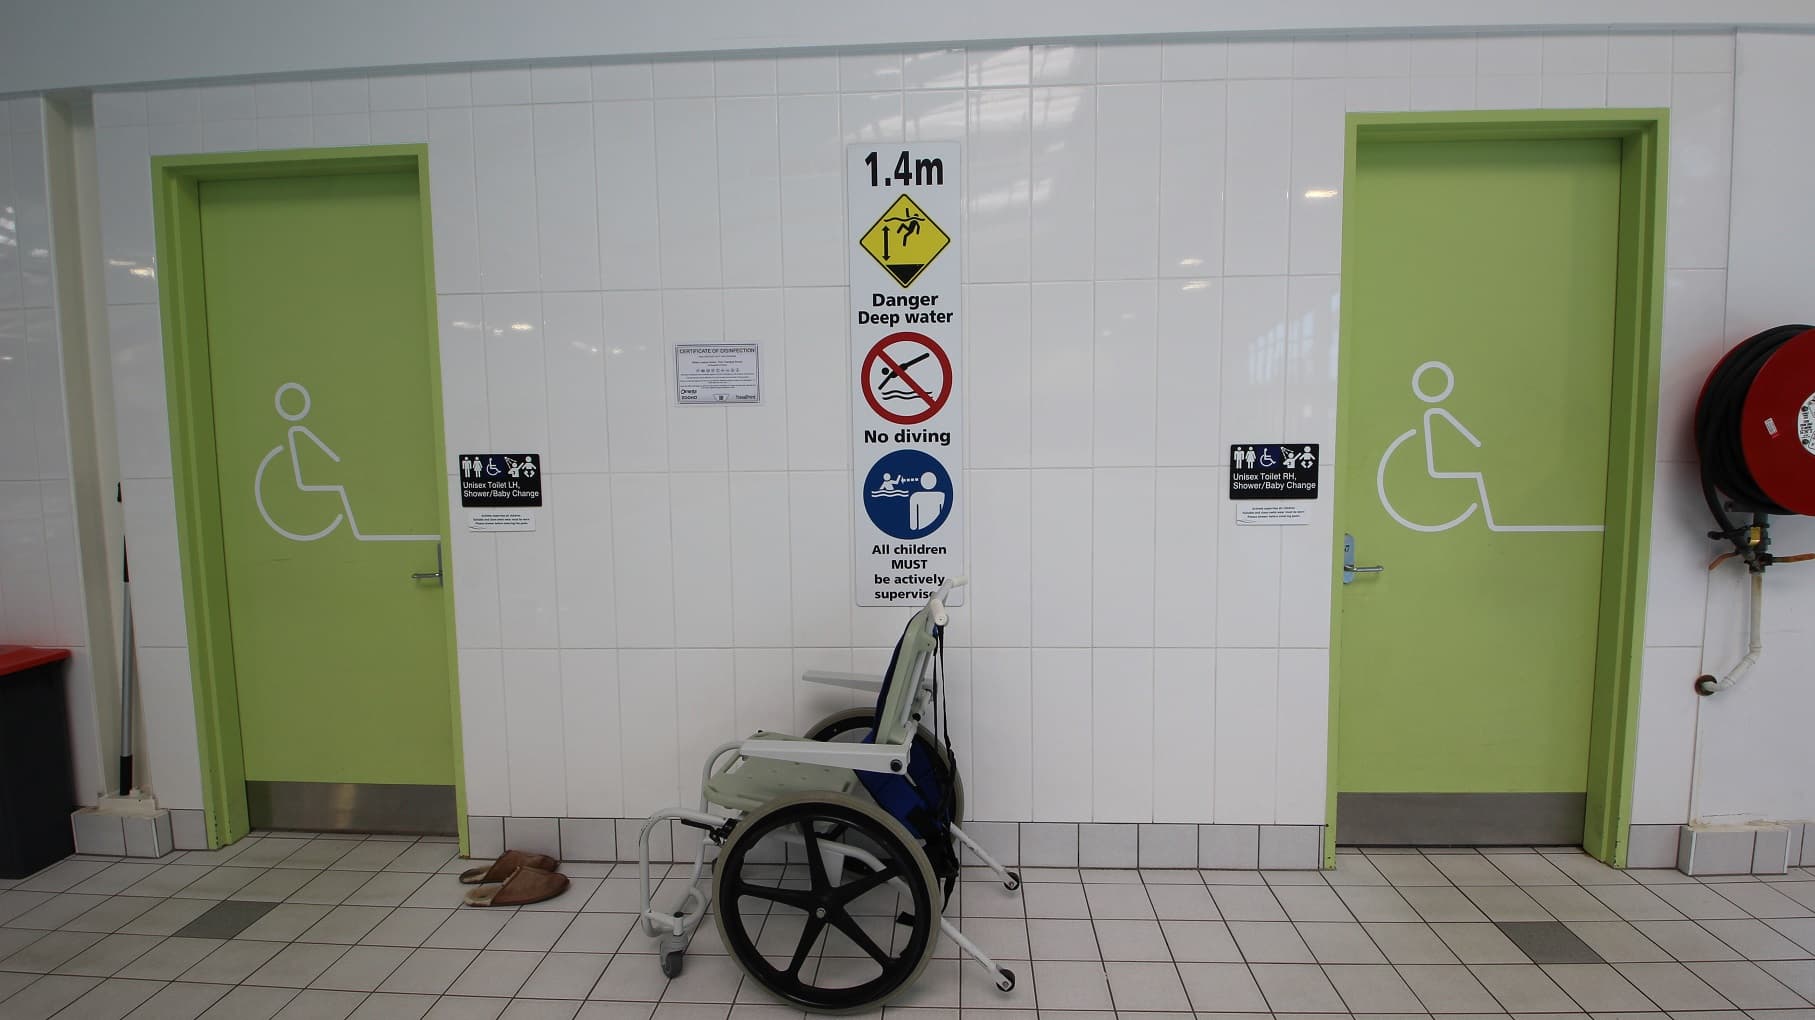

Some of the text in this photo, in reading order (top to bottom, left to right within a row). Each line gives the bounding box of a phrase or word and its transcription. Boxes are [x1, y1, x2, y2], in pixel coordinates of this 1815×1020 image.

[865, 150, 944, 187] 1.4m
[872, 292, 939, 310] Danger
[858, 310, 954, 327] Deep water
[864, 429, 951, 446] No diving
[1233, 472, 1297, 481] Unisex Toilet RH,
[462, 481, 487, 489] Unisex
[487, 481, 507, 489] Toilet
[1232, 481, 1317, 491] Shower/Baby Change
[463, 490, 540, 499] Shower/Baby Change
[872, 544, 947, 555] All children
[891, 559, 928, 570] MUST
[874, 573, 945, 587] be actively
[874, 588, 934, 601] supervis
